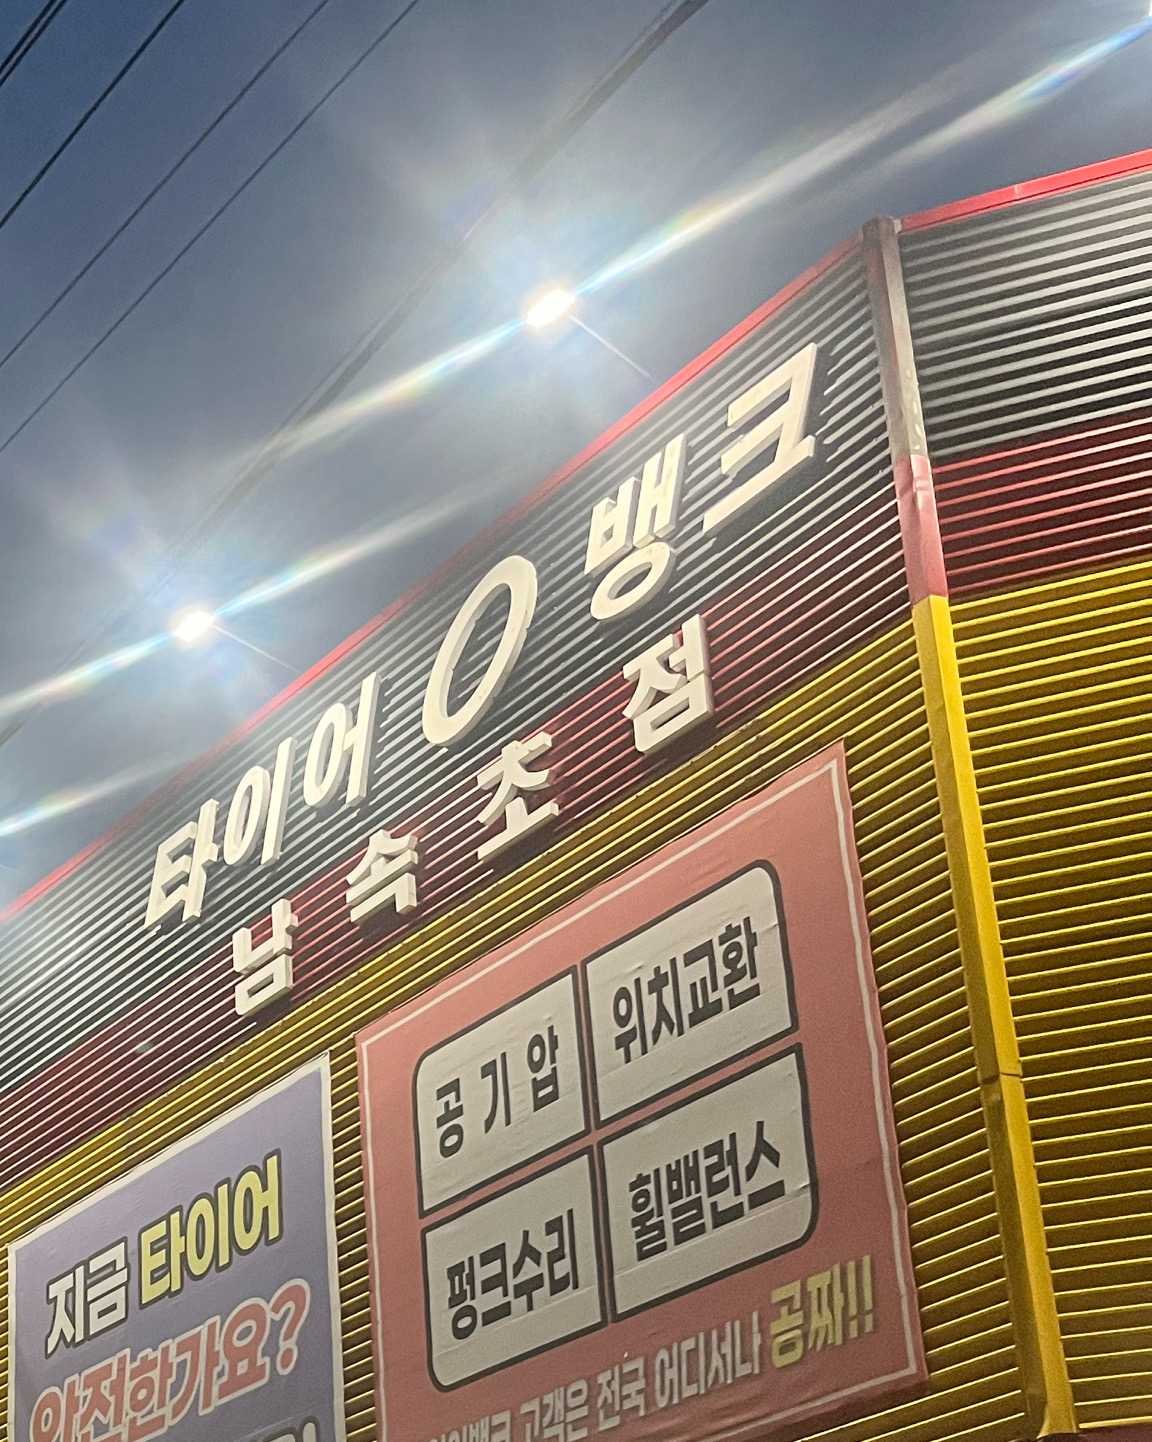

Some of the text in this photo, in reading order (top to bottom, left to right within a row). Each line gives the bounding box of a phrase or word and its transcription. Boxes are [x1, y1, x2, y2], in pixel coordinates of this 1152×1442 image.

[145, 671, 382, 930] 타이어
[583, 342, 818, 620] 뱅크
[612, 916, 762, 1066] 위치교환
[435, 1025, 560, 1160] 공기압
[46, 1150, 283, 1356] 지금 타이어
[627, 1120, 787, 1263] 휠밸런스
[446, 1206, 580, 1341] 펑크수리
[595, 1354, 647, 1433] 전국
[653, 1311, 763, 1408] 어디서나
[768, 1254, 877, 1370] 공짜!!
